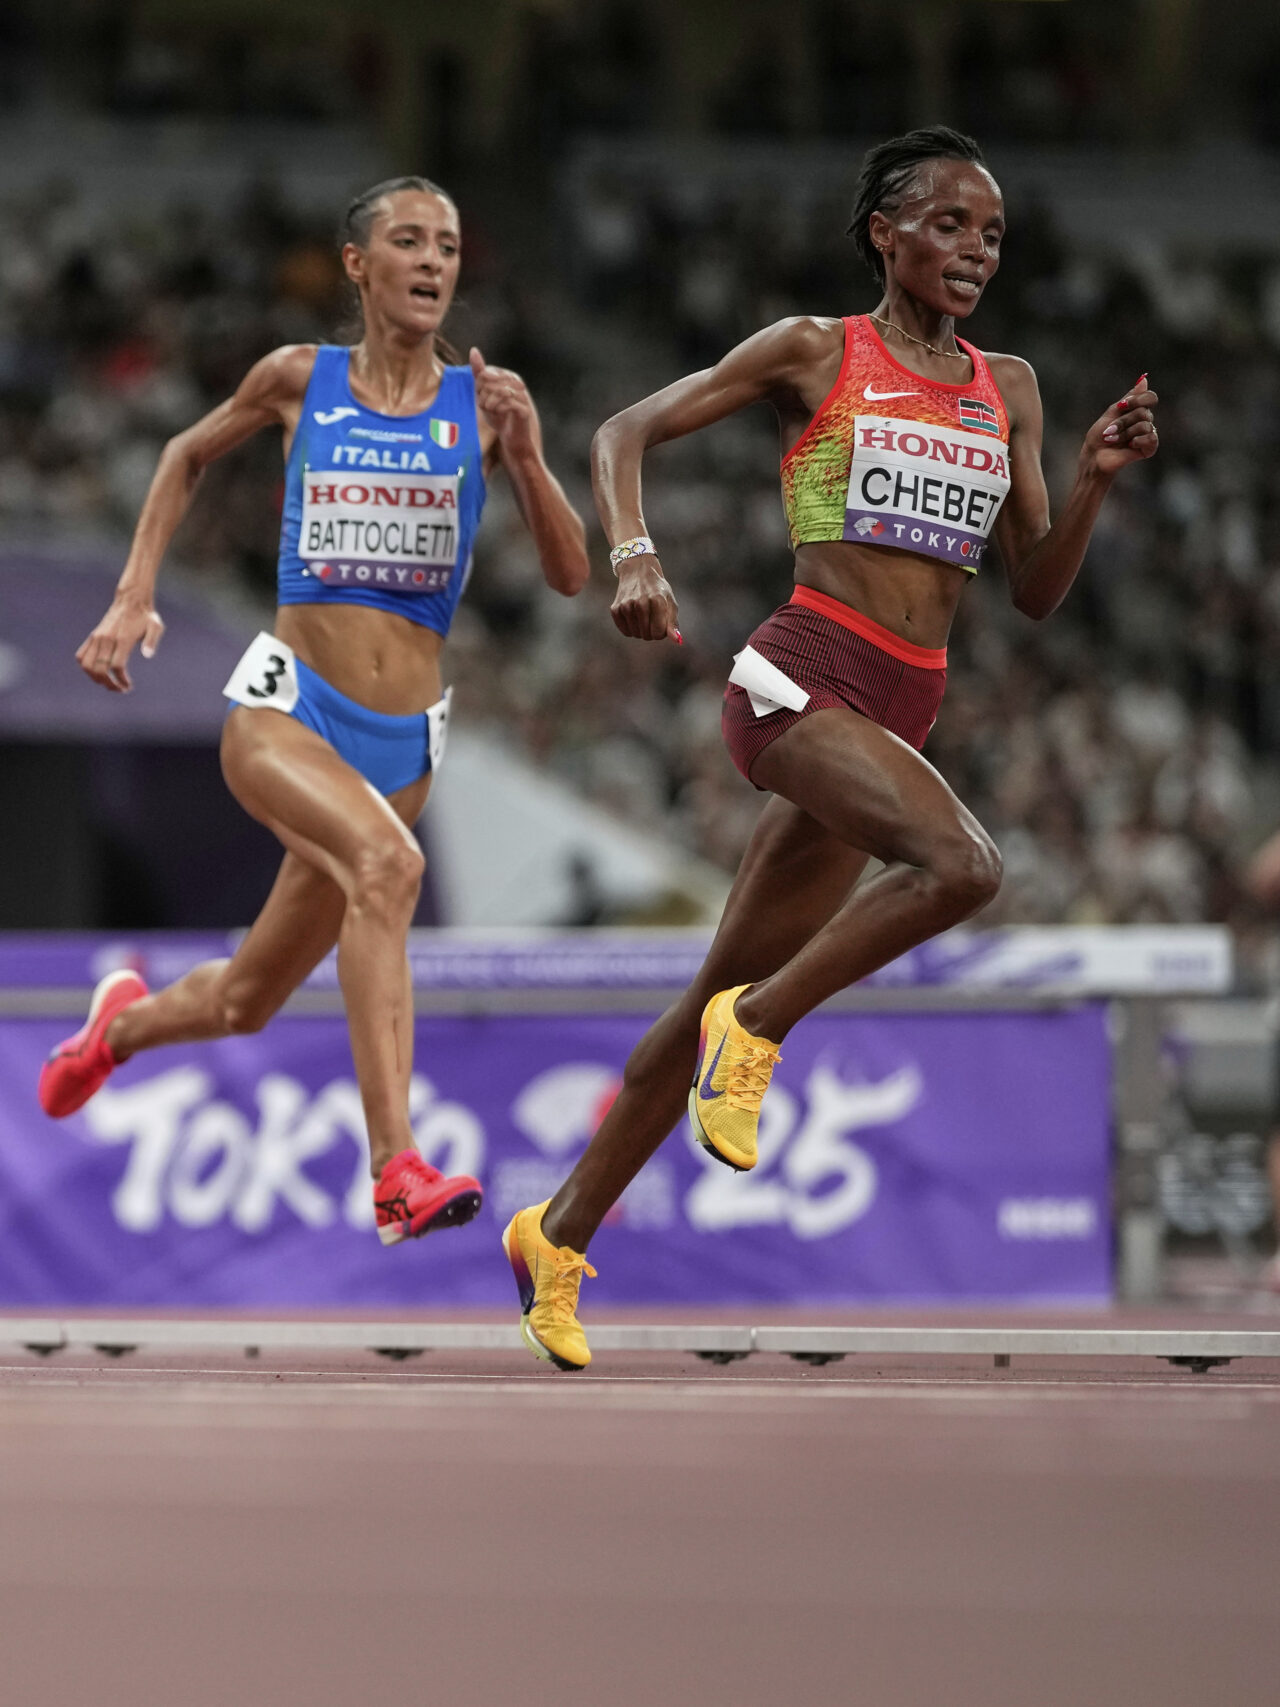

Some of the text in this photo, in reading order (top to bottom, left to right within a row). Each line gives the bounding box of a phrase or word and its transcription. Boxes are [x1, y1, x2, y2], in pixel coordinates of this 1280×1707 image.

[331, 445, 431, 472] ITALIA
[859, 428, 1008, 480] HONDA
[309, 484, 456, 509] HONDA
[861, 467, 1000, 531] CHEBET
[247, 654, 286, 698] 3
